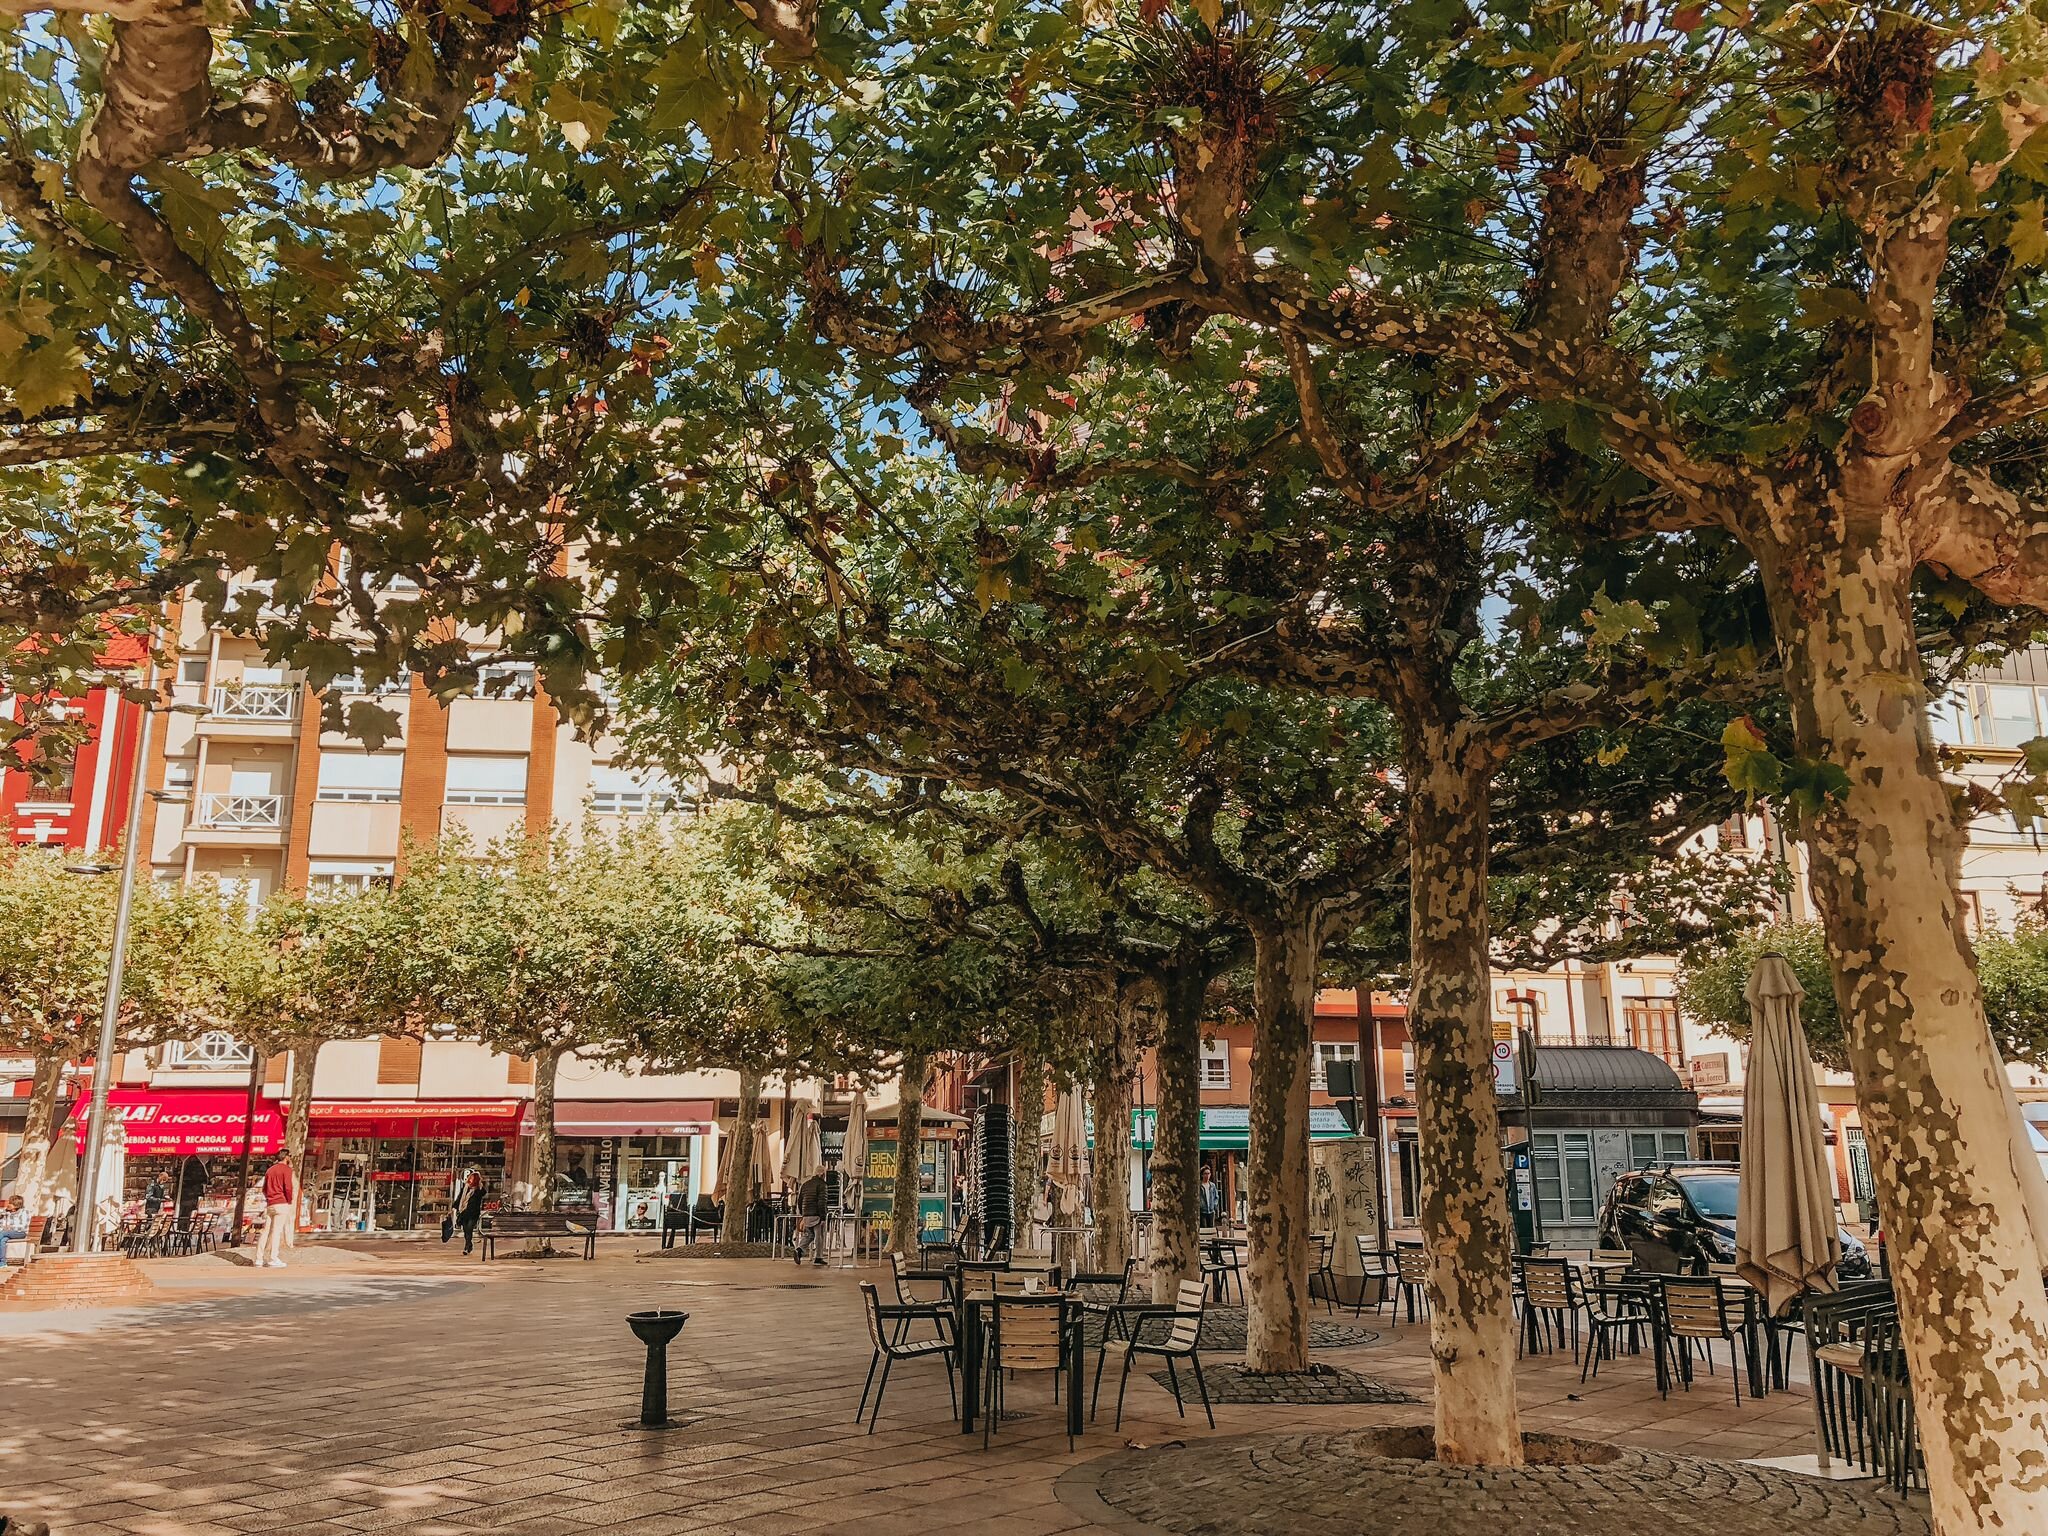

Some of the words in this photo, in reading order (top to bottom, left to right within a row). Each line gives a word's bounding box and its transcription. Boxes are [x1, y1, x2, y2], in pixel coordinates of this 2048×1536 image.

[310, 1106, 334, 1115] eprof
[159, 1114, 222, 1123] KIOSCO
[870, 1153, 896, 1164] BIEN
[1518, 1154, 1527, 1168] P
[867, 1165, 896, 1178] JUGADO
